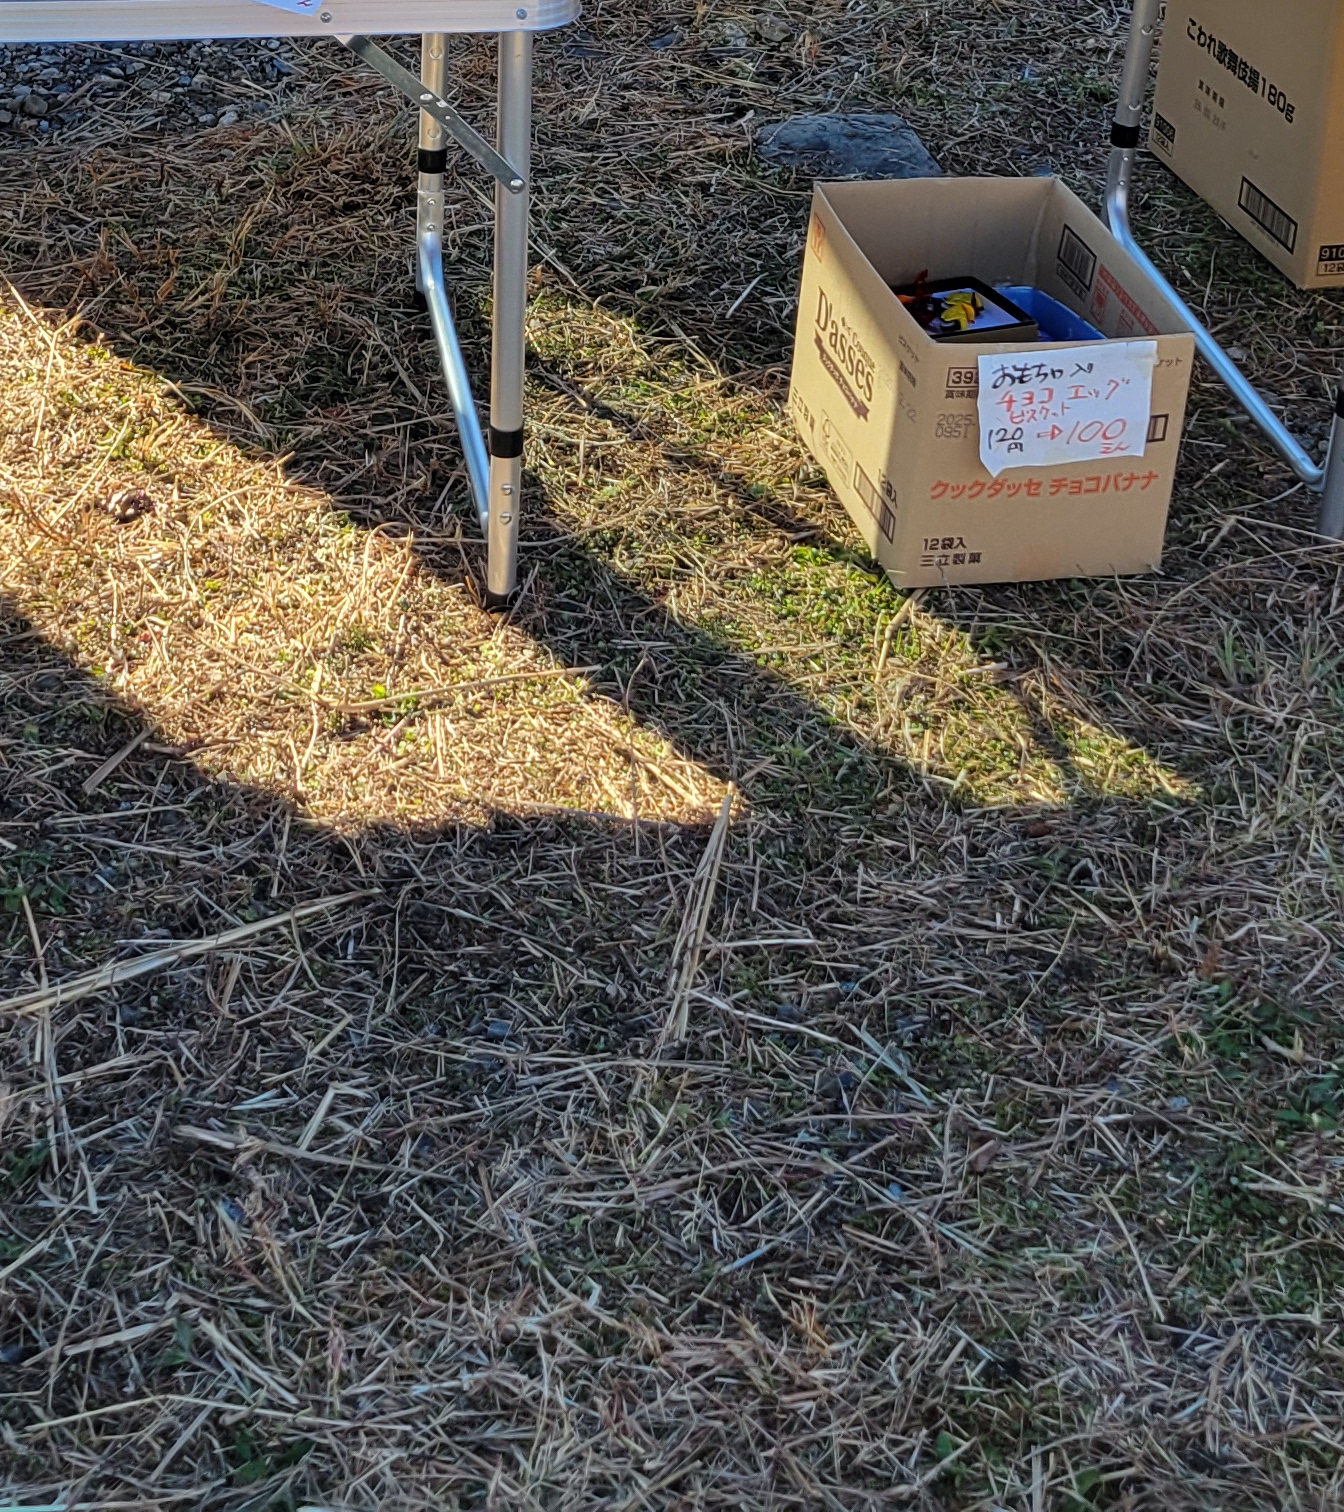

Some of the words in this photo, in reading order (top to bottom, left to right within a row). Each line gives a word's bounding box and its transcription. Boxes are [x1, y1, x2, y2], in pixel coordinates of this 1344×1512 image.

[1186, 16, 1297, 125] こわれ歌舞伎揚180g
[986, 426, 1024, 451] 120
[929, 479, 1043, 501] クックダッセ
[1048, 470, 1159, 497] チョコバナナ
[923, 536, 967, 552] 12袋入
[919, 551, 983, 568] 三立製菓
